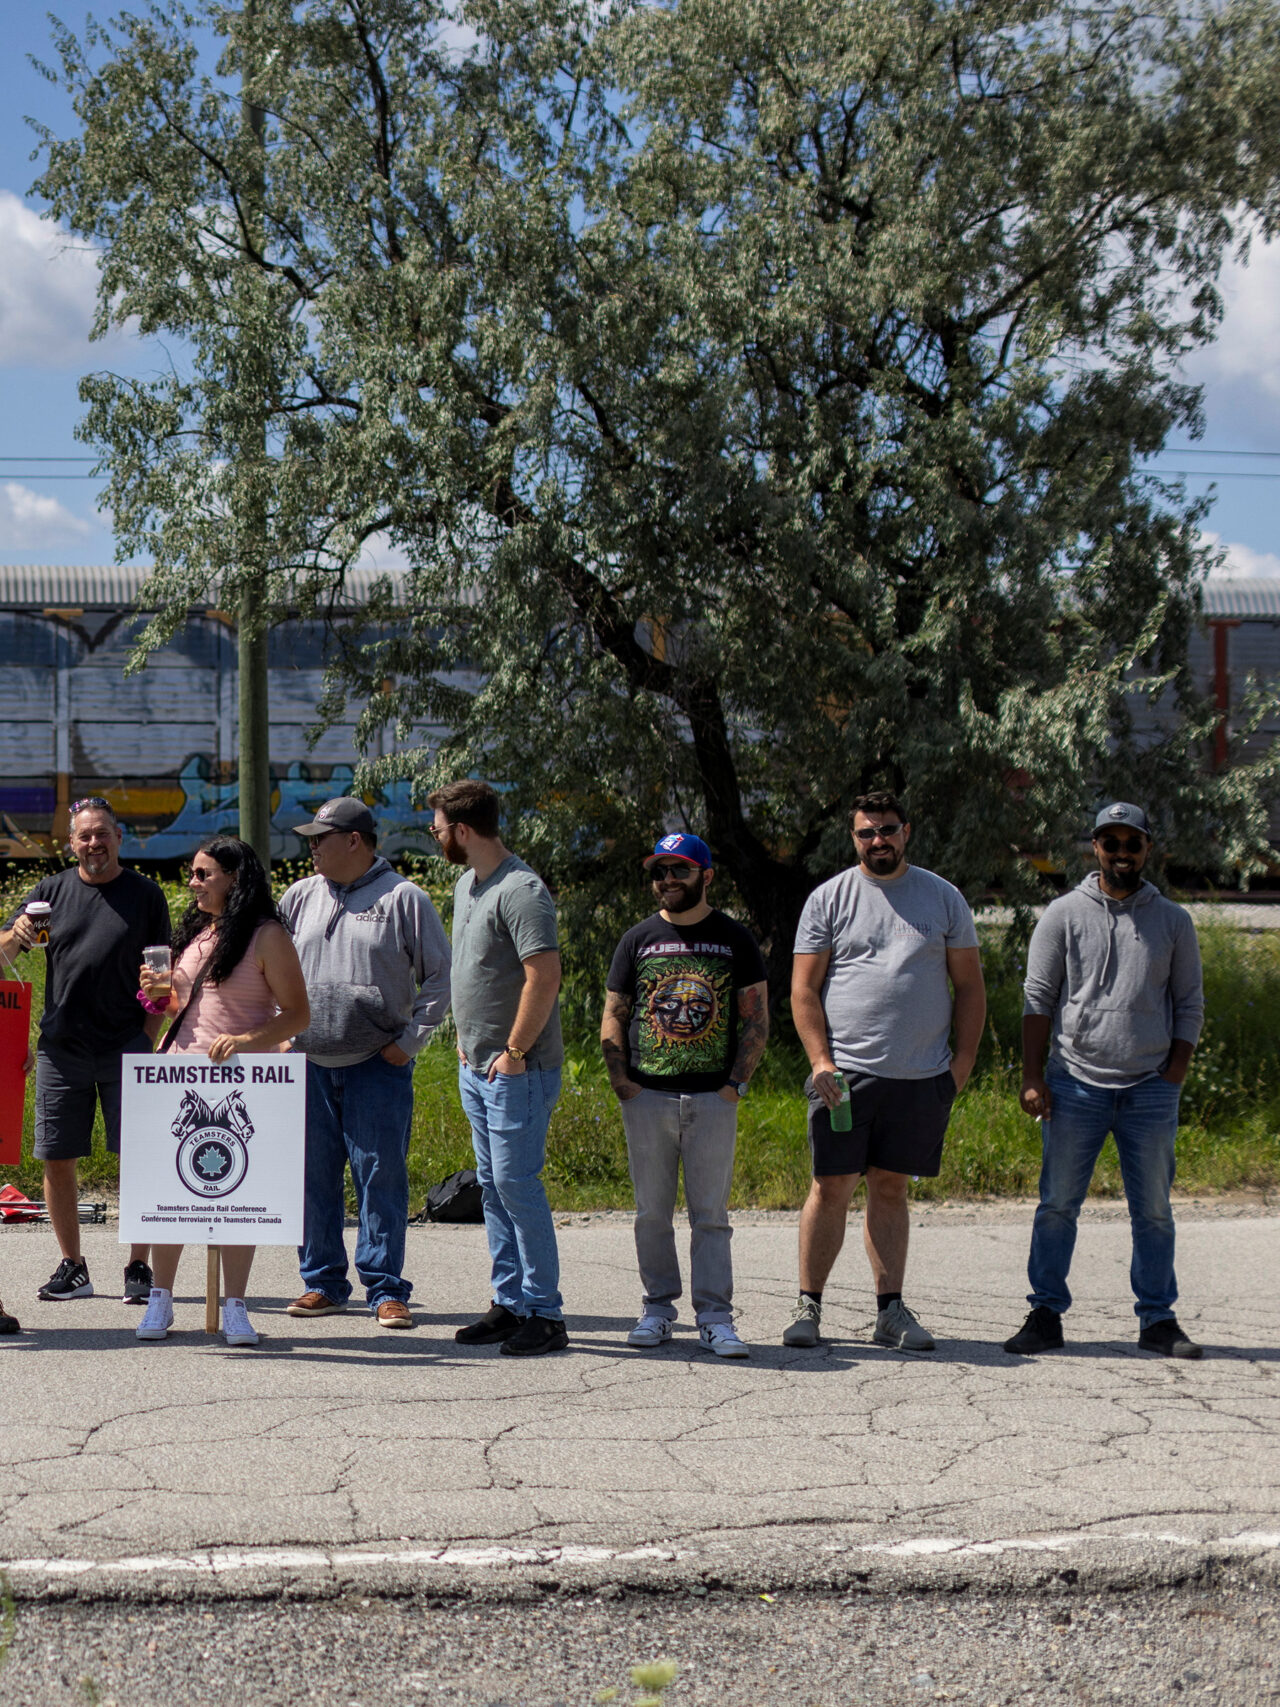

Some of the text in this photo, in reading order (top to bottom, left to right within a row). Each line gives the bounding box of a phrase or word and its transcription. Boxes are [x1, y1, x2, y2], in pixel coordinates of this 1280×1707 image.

[33, 918, 50, 929] McC
[355, 914, 391, 924] adidas
[637, 943, 733, 957] SUBLIME
[134, 1065, 295, 1084] TEAMSTERS RAIL
[189, 1131, 235, 1146] TEAMSTERS
[157, 1204, 190, 1212] Teamsters
[191, 1204, 215, 1212] Canada
[230, 1205, 267, 1213] Conference
[141, 1215, 177, 1223] Conférence
[178, 1215, 212, 1223] ferroviaire
[223, 1216, 256, 1224] Teamsters
[257, 1216, 282, 1224] Canada
